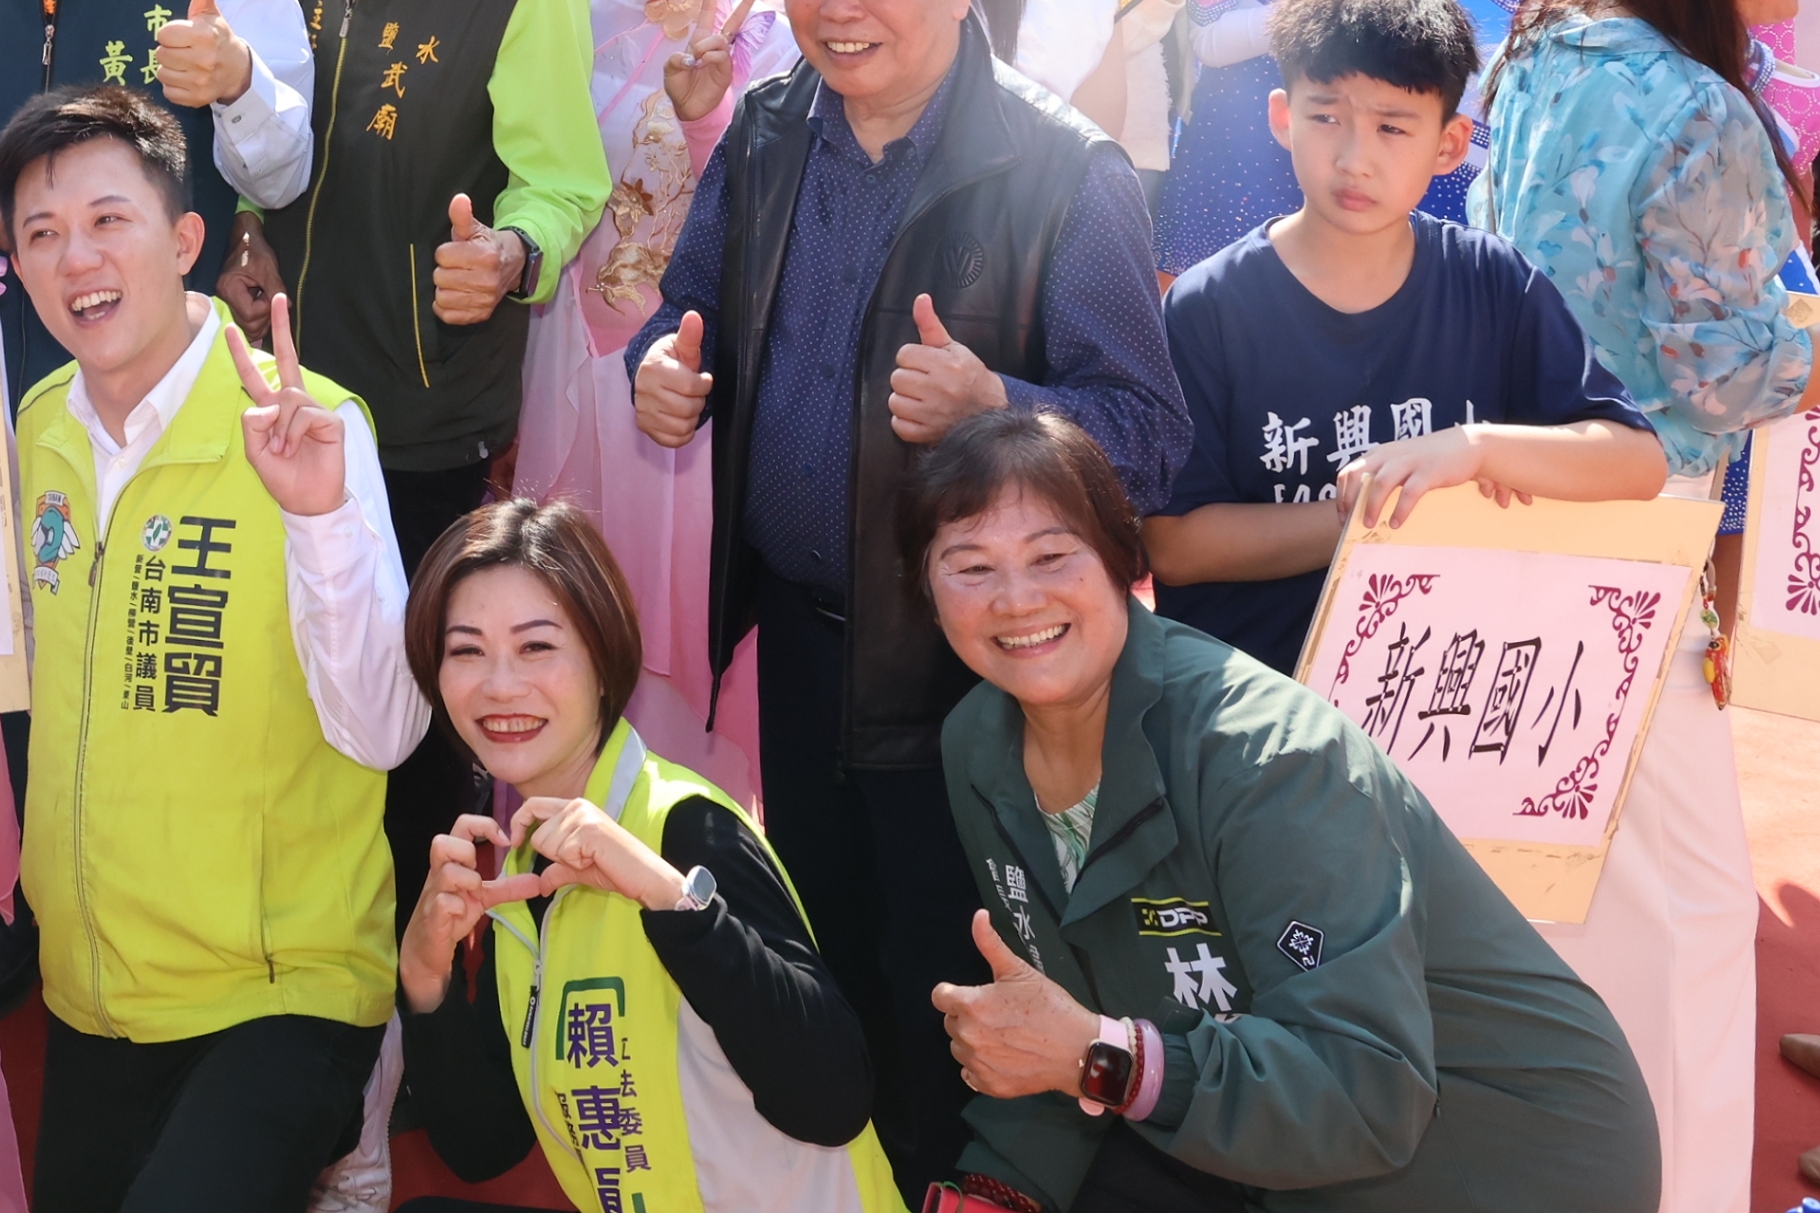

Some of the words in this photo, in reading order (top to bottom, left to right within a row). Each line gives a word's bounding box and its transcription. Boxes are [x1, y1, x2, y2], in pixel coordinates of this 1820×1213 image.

[99, 40, 134, 86] 黃
[133, 555, 166, 712] 台南市議員
[161, 515, 237, 717] 王宣貿
[1362, 622, 1584, 766] 新興國小
[1157, 907, 1209, 928] DPP
[1164, 942, 1238, 1012] 林
